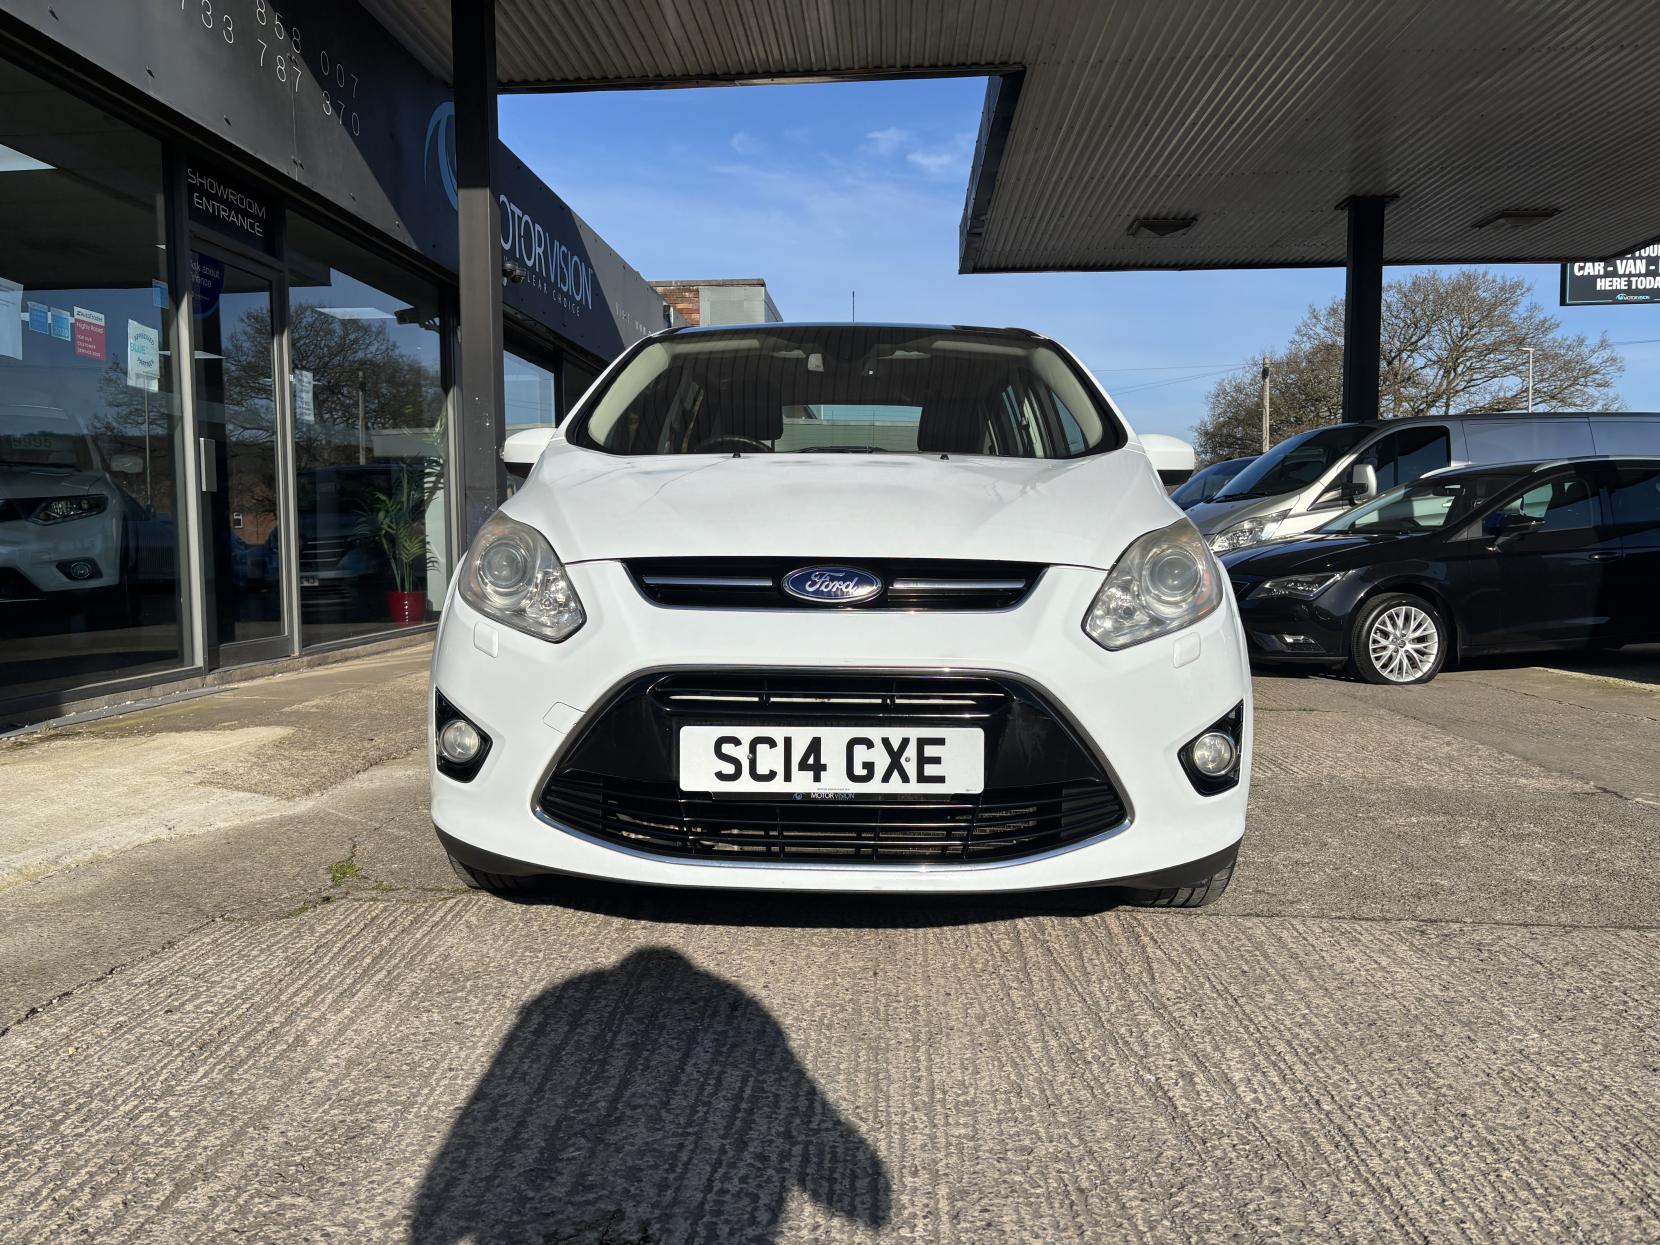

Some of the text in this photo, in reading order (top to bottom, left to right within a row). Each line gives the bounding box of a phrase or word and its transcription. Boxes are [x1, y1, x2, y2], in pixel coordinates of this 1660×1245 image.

[257, 39, 302, 93] 787
[322, 90, 360, 136] 370
[320, 50, 359, 98] 007
[187, 168, 267, 220] SHOWROOM
[193, 194, 264, 237] ENTRANCE
[1573, 262, 1605, 276] CAR
[1616, 259, 1646, 275] VAN
[1596, 278, 1628, 290] HERE
[552, 289, 580, 318] CHOICE
[805, 571, 859, 592] Ford
[713, 735, 946, 784] SC14 GXE
